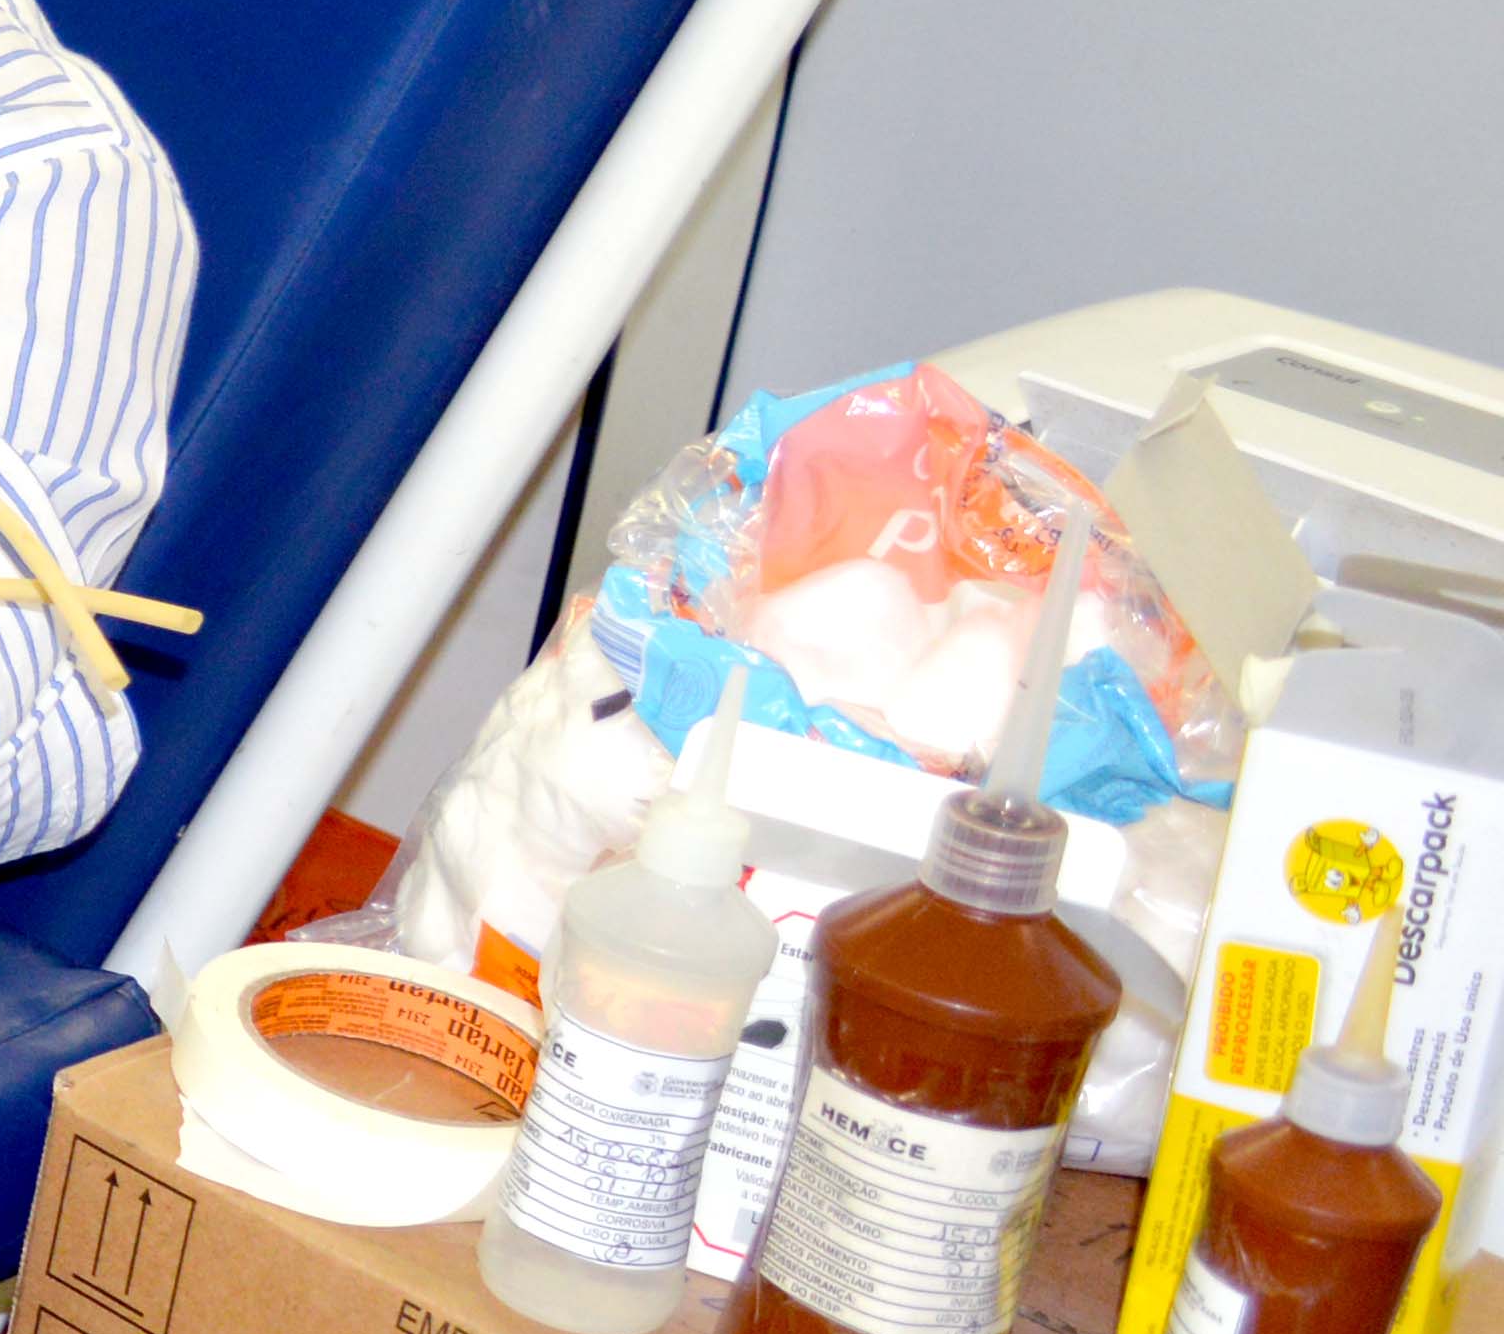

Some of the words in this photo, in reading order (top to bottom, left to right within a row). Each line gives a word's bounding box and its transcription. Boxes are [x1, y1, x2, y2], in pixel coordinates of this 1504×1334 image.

[1394, 792, 1457, 987] Descarpack
[397, 1006, 431, 1027] 2314
[1212, 970, 1235, 1057] PROIBIDO
[1229, 957, 1258, 1076] REPROCESSAR
[447, 1017, 529, 1080] Tartan
[454, 1053, 484, 1077] 2314
[598, 1107, 671, 1129] OXIGENADA
[595, 1212, 666, 1229] CORROSIVA
[582, 1227, 609, 1240] USO
